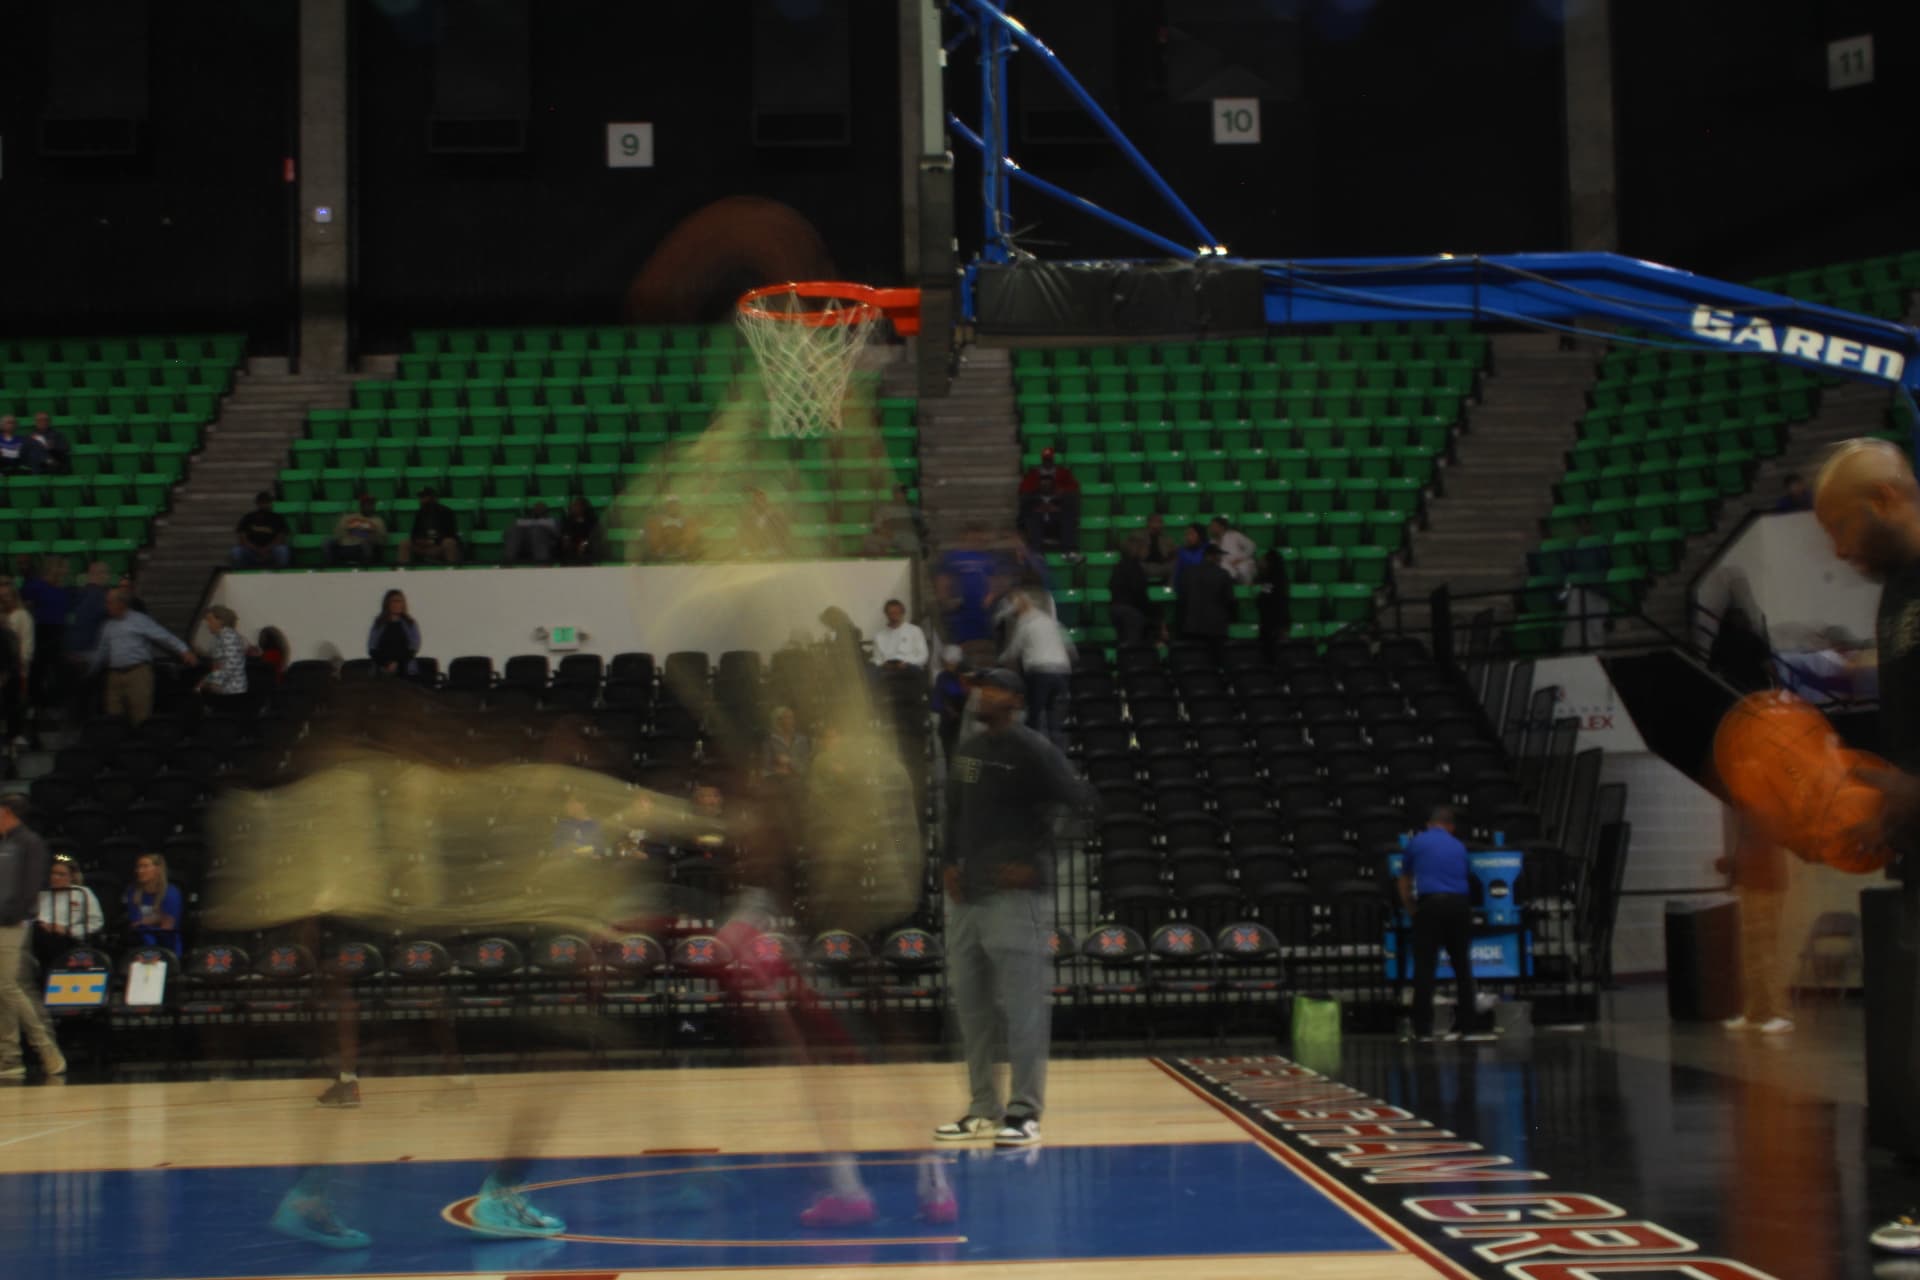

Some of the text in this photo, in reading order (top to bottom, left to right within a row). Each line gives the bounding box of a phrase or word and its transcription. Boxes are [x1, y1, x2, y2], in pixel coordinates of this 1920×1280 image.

[1838, 48, 1864, 76] 11
[1221, 109, 1253, 134] 10
[621, 133, 640, 157] 9
